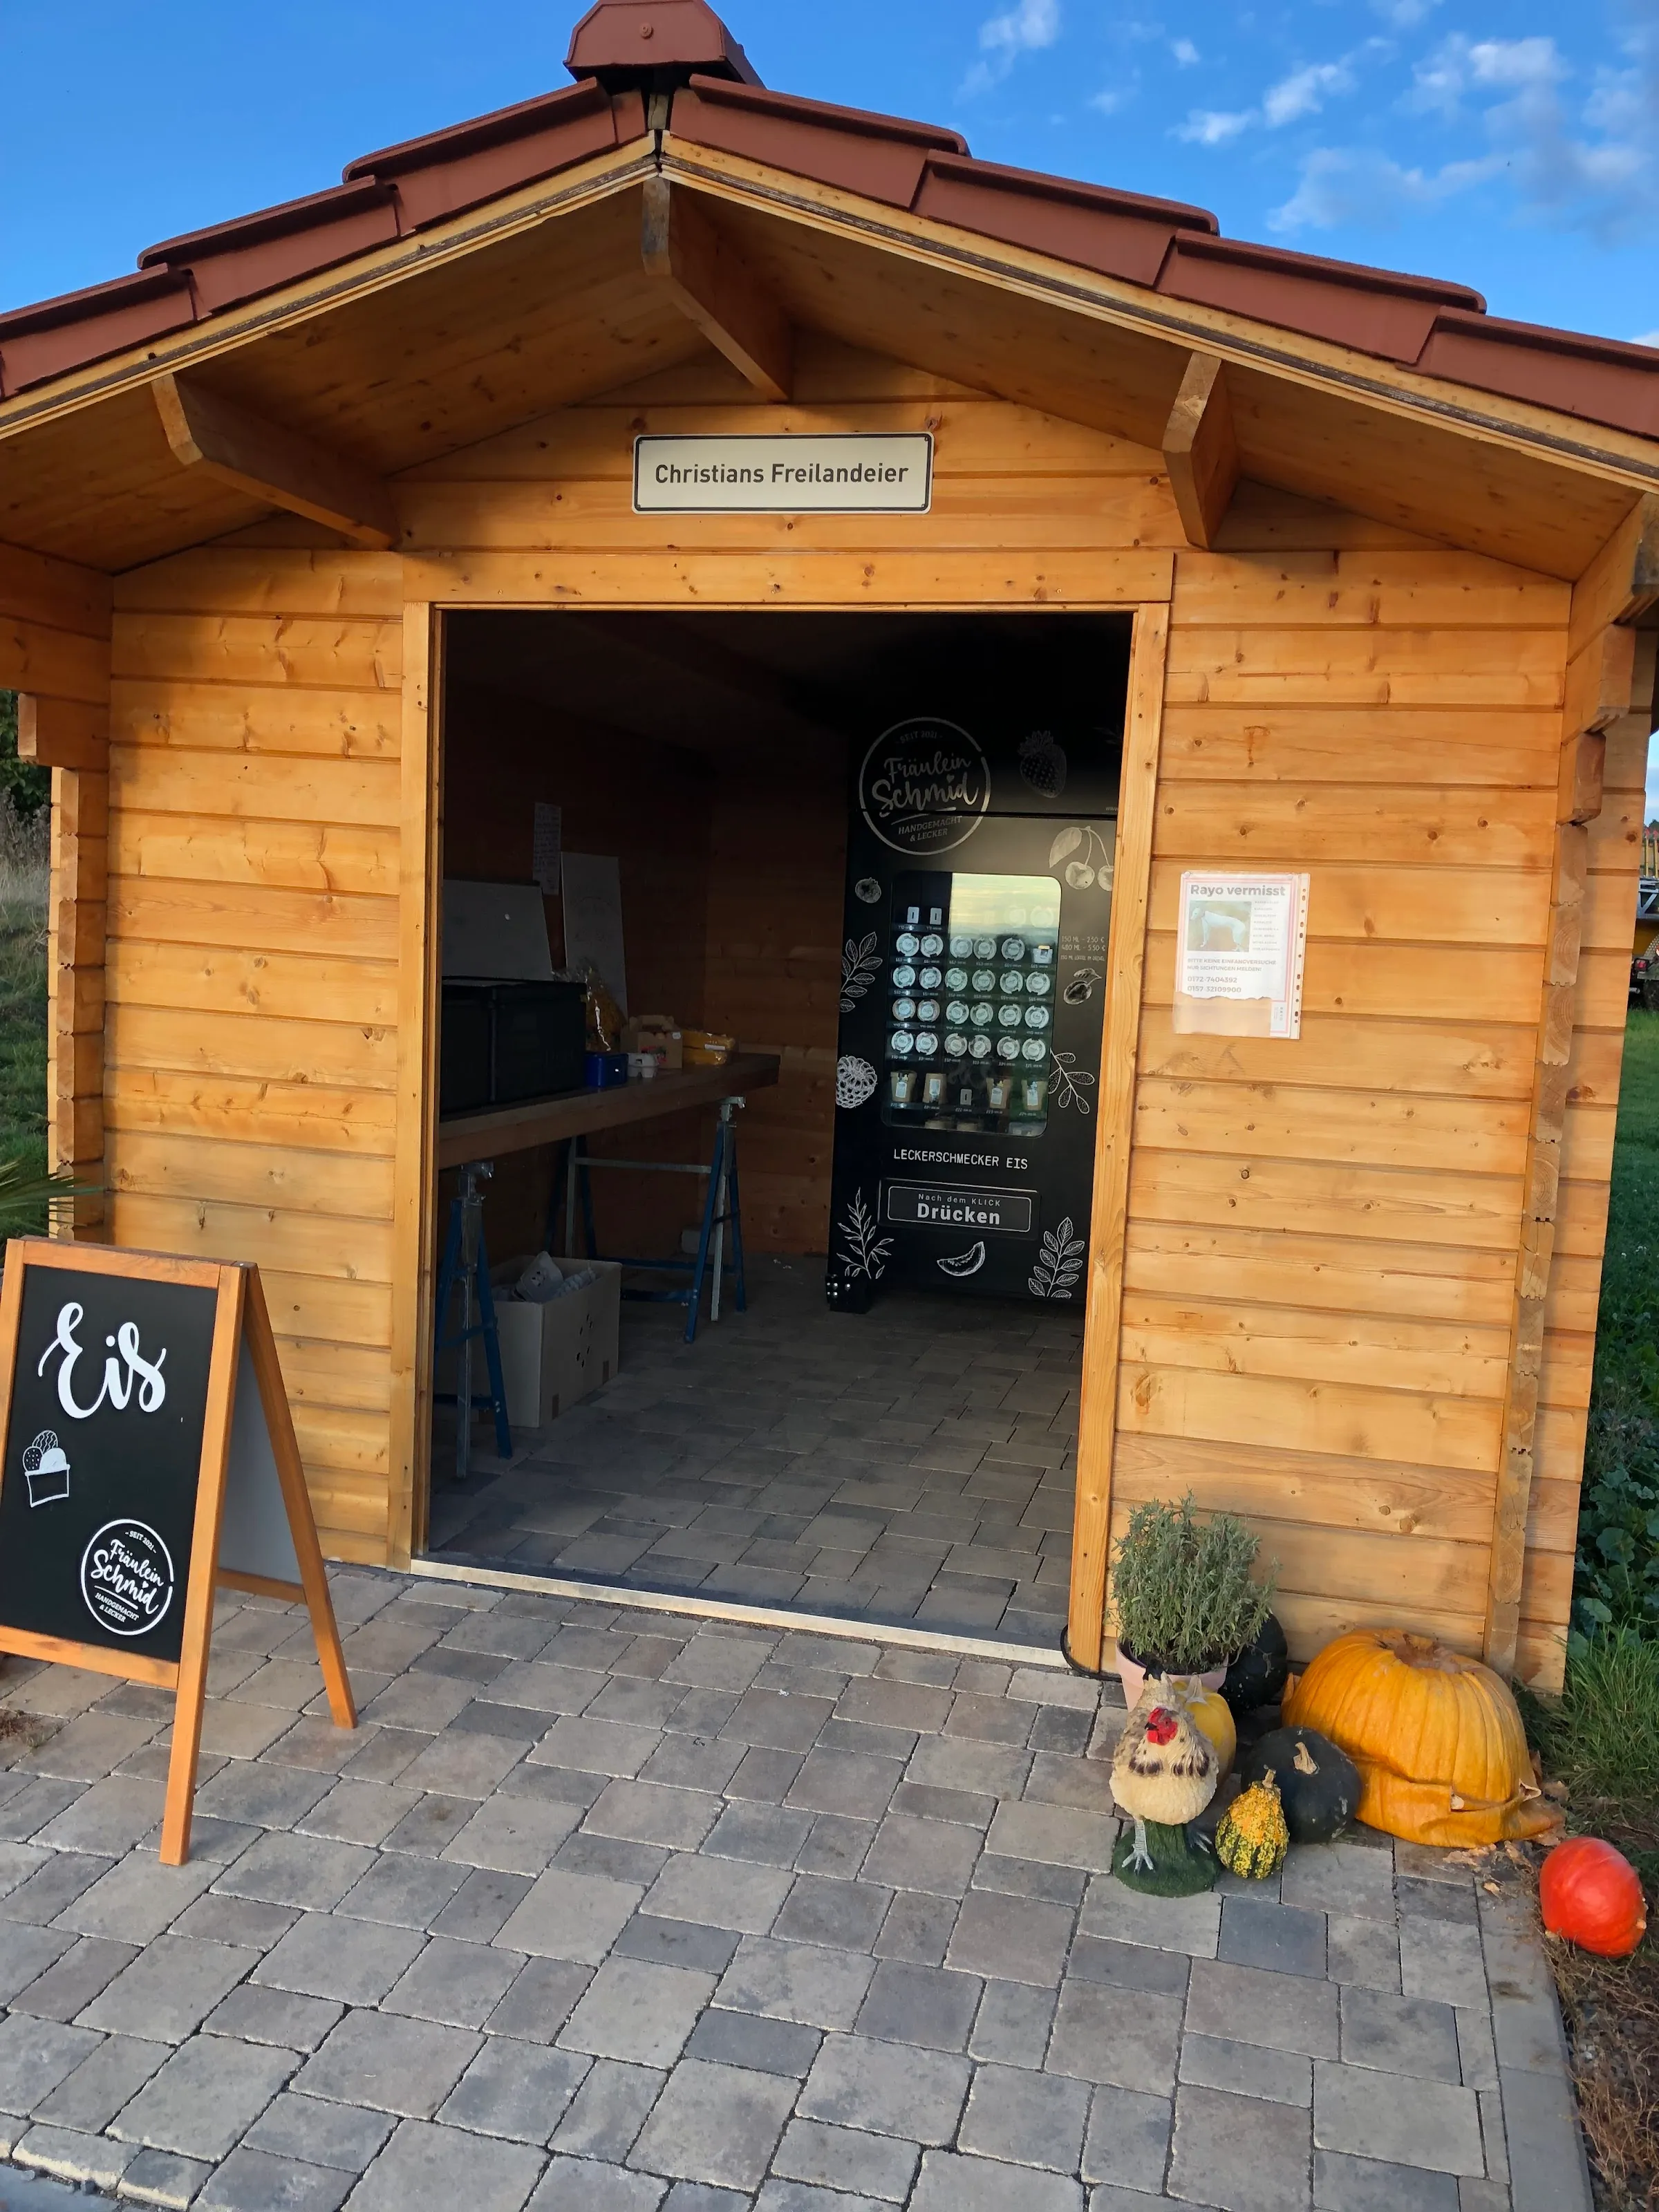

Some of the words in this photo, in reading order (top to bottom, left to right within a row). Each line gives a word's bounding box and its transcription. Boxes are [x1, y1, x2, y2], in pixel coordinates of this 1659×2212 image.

[655, 463, 764, 484] Christians
[771, 462, 909, 483] Freilandeier
[883, 750, 972, 785] Fräulein
[872, 771, 979, 818] Schmid
[898, 815, 963, 835] HANDGEMACHT
[917, 828, 948, 841] LECKER
[1190, 885, 1224, 897] Rayo
[1227, 885, 1286, 897] vermisst
[893, 1148, 1000, 1167] LECKERSCHMECKER
[1006, 1157, 1028, 1170] EIS
[918, 1193, 941, 1202] Nach
[947, 1196, 966, 1204] dem
[971, 1197, 1001, 1207] KLICK
[917, 1202, 1001, 1226] Drücken
[37, 1302, 167, 1419] Eis
[129, 1530, 144, 1541] SEIT
[142, 1537, 155, 1550] 2021
[109, 1539, 165, 1587] Fräulein
[91, 1549, 159, 1615] Schmid
[94, 1592, 140, 1621] HANDGEMACHT
[104, 1604, 126, 1623] LECKER
